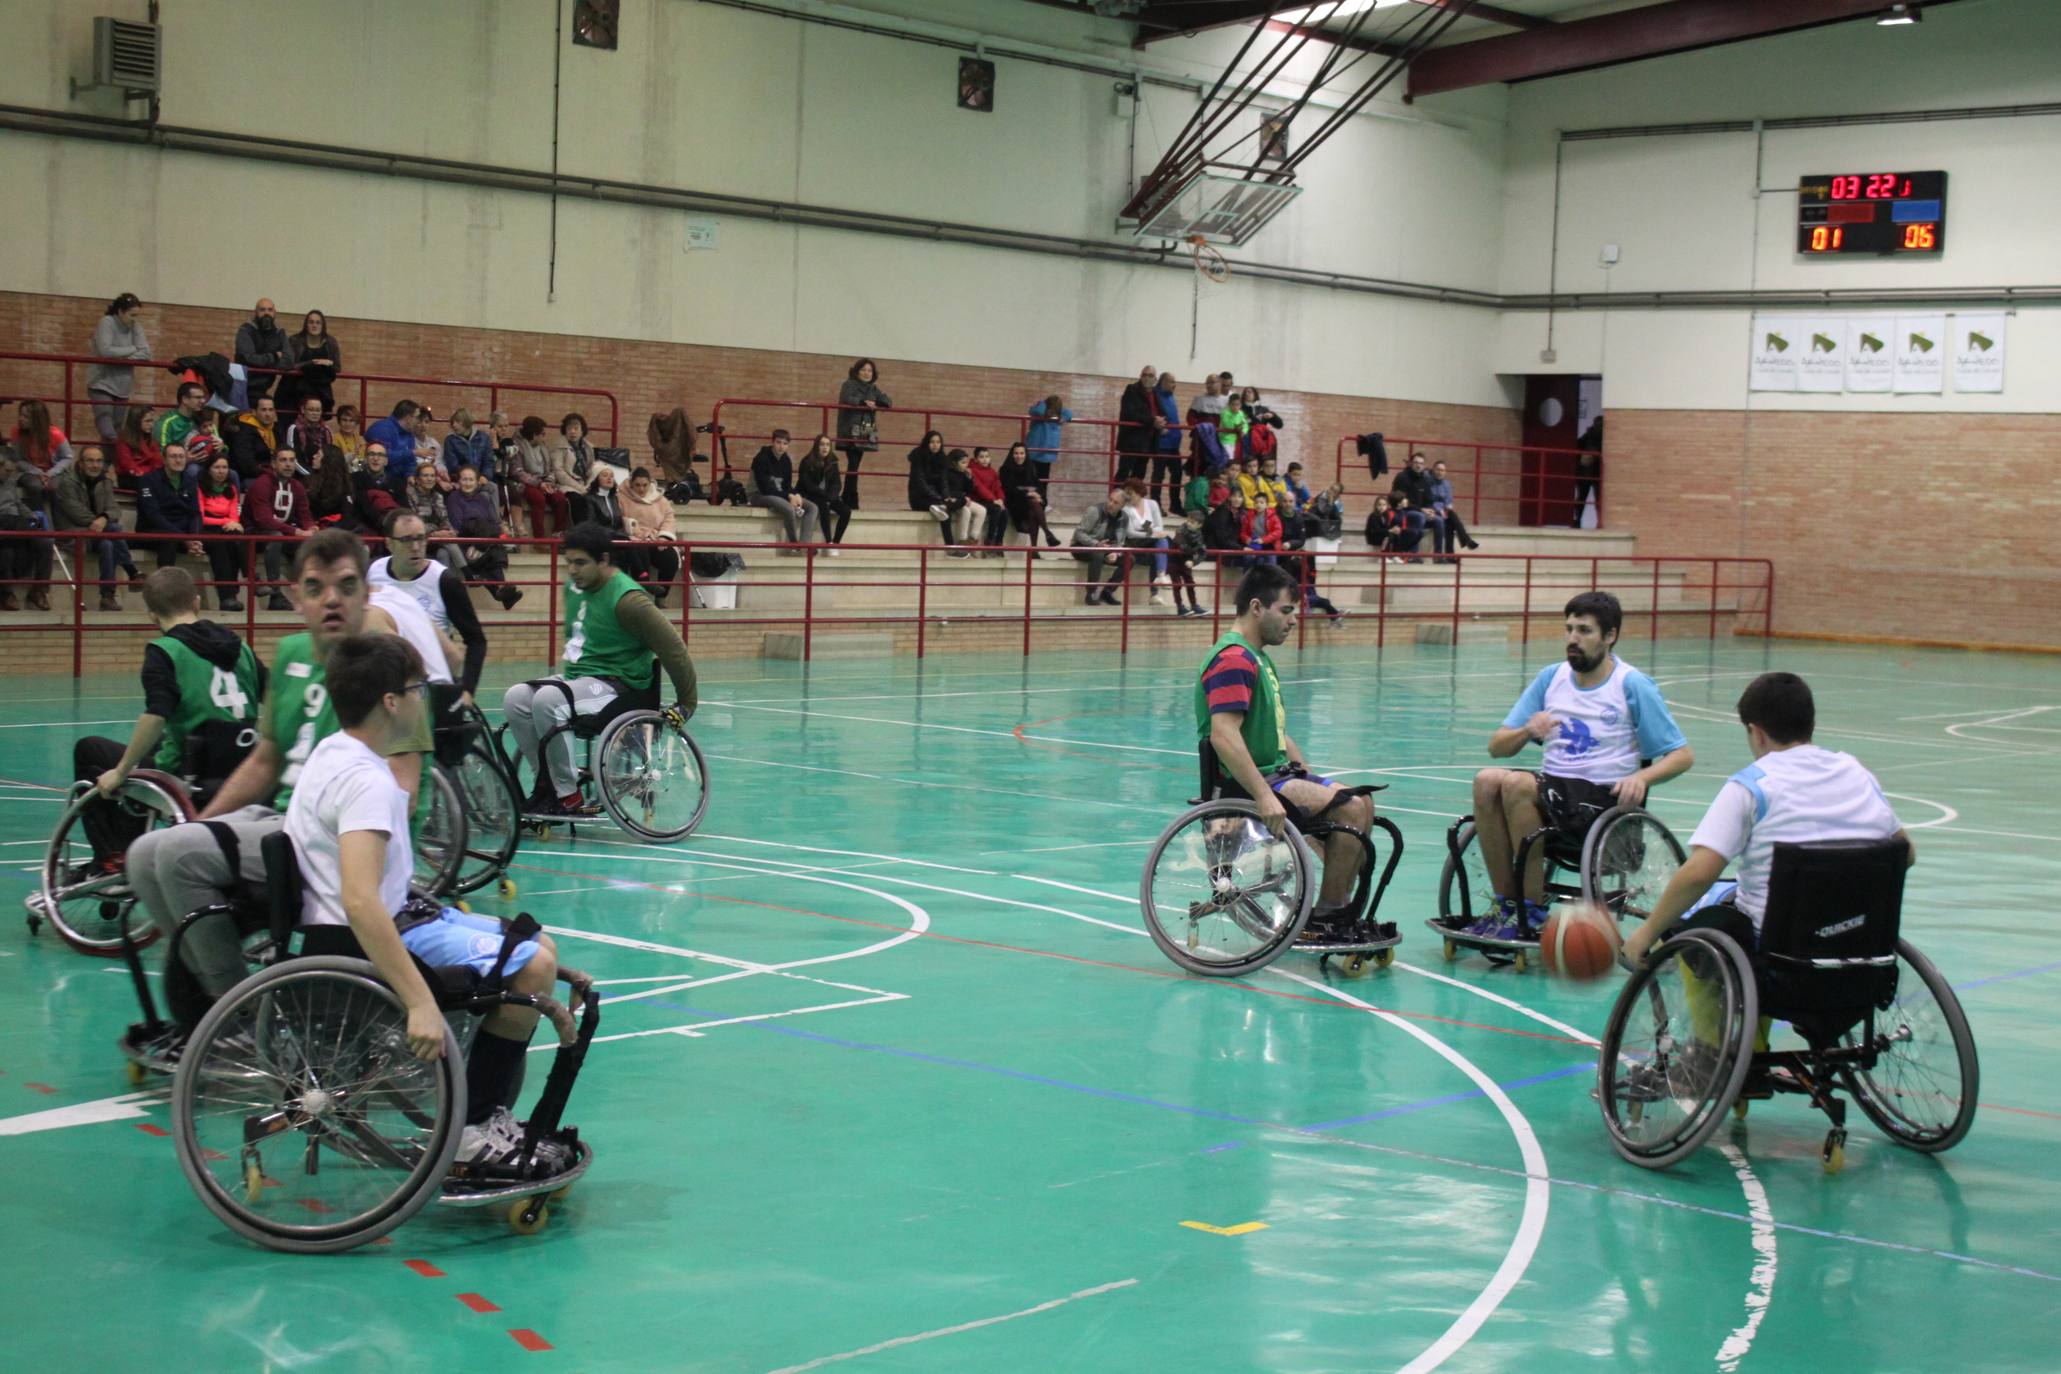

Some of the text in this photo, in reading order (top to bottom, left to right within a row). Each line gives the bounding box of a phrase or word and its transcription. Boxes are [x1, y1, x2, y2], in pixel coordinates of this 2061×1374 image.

[1812, 226, 1842, 250] 01
[210, 666, 248, 719] 4
[304, 683, 326, 717] 9
